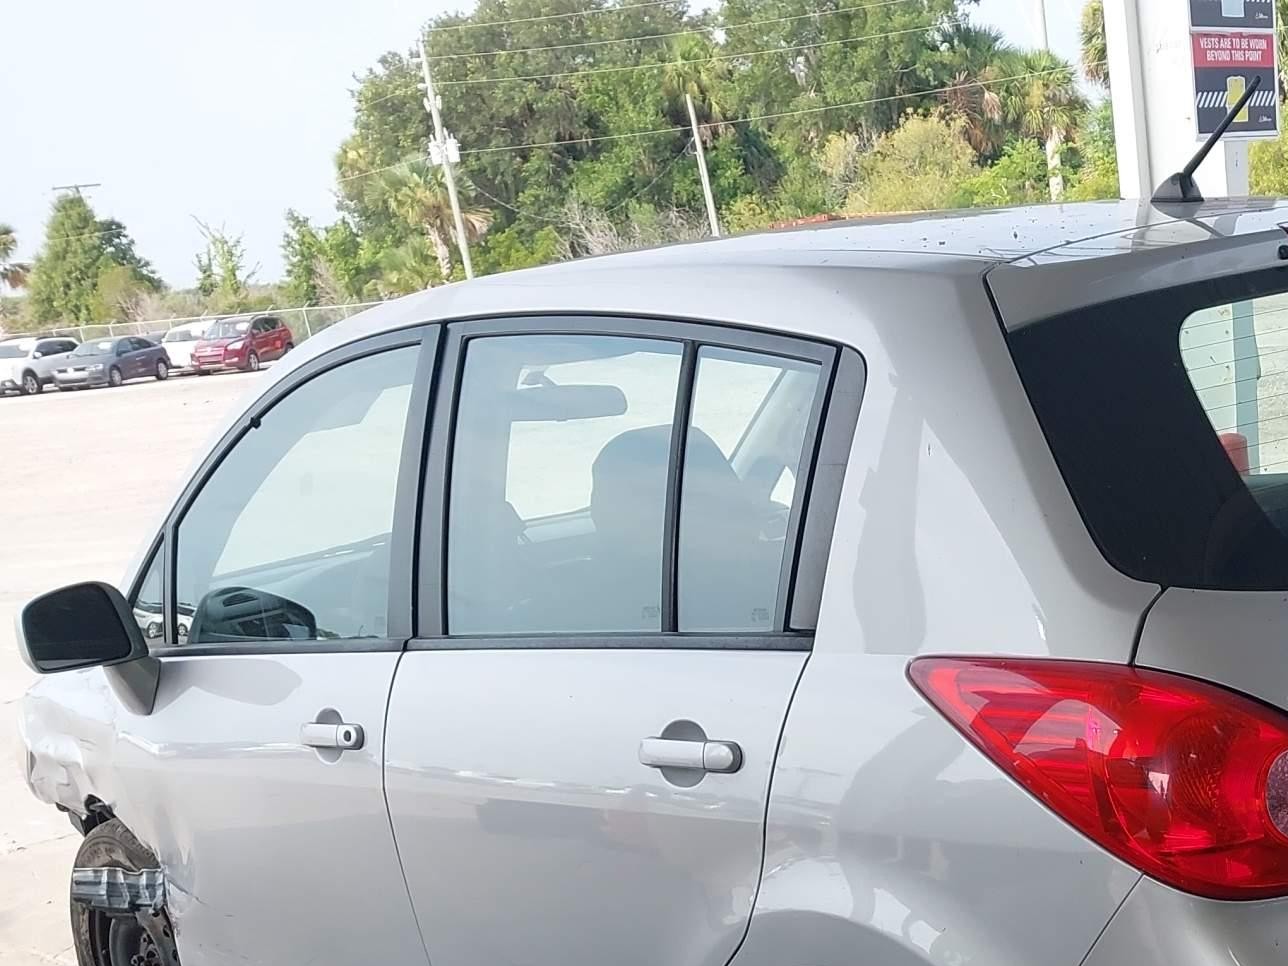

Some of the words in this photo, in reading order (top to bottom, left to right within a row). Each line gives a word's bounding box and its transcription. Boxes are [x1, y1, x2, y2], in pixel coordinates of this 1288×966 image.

[1200, 38, 1219, 49] VESTS
[1220, 39, 1232, 49] ARE
[1232, 39, 1241, 49] TO
[1241, 39, 1249, 50] BE
[1249, 39, 1267, 50] WORN
[1207, 51, 1231, 61] BEYOND
[1231, 51, 1244, 61] THIS
[1245, 51, 1262, 62] POINT
